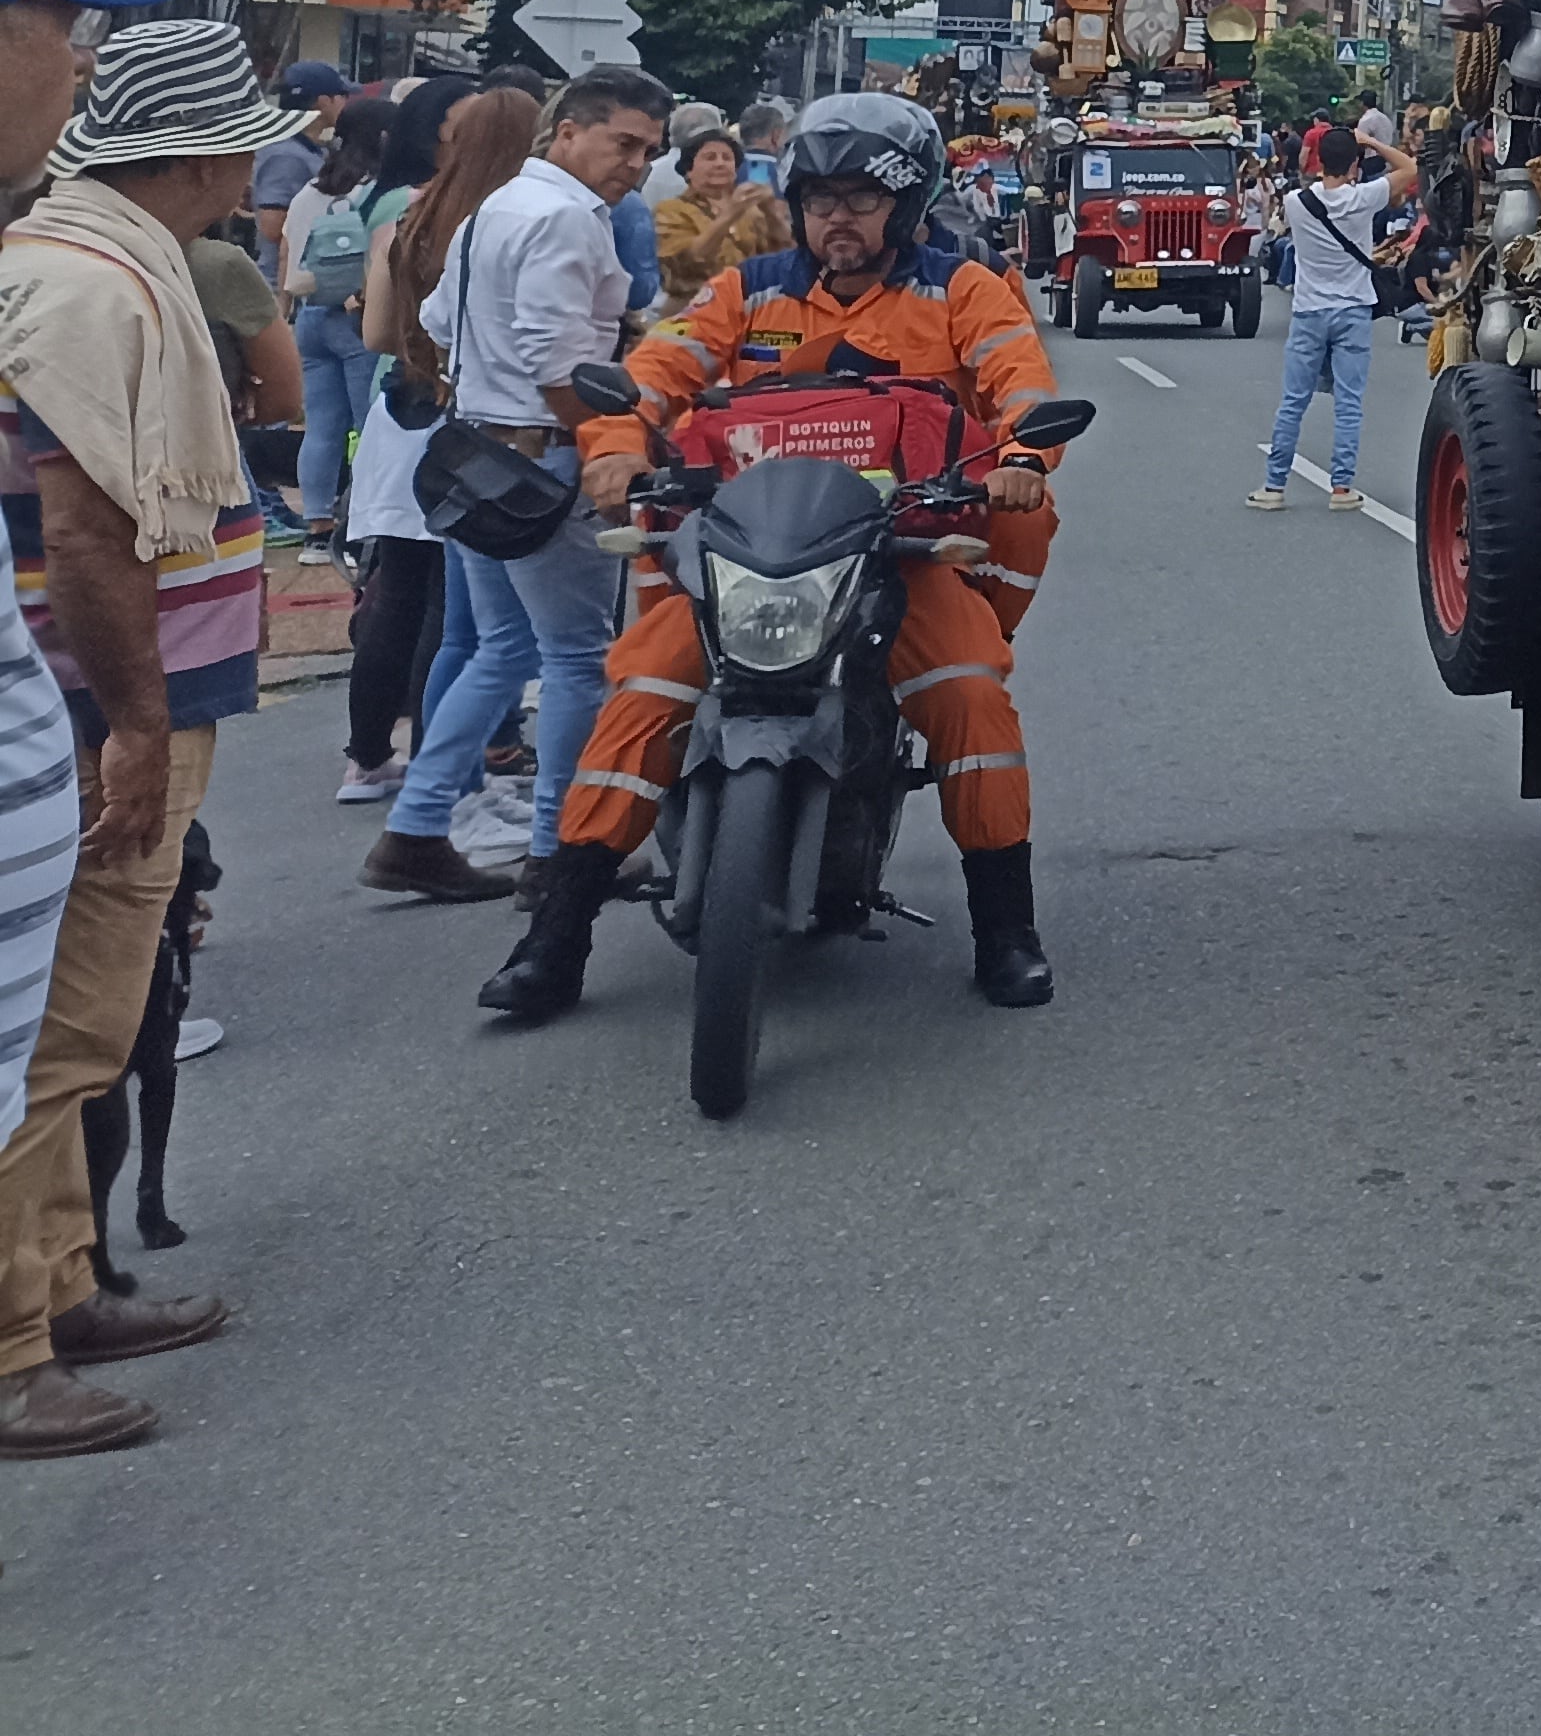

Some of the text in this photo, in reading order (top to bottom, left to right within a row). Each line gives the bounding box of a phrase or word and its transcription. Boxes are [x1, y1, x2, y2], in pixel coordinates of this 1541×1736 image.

[1090, 162, 1104, 177] 2
[789, 419, 871, 436] BOTIQUIN
[785, 435, 875, 453] PRIMEROS
